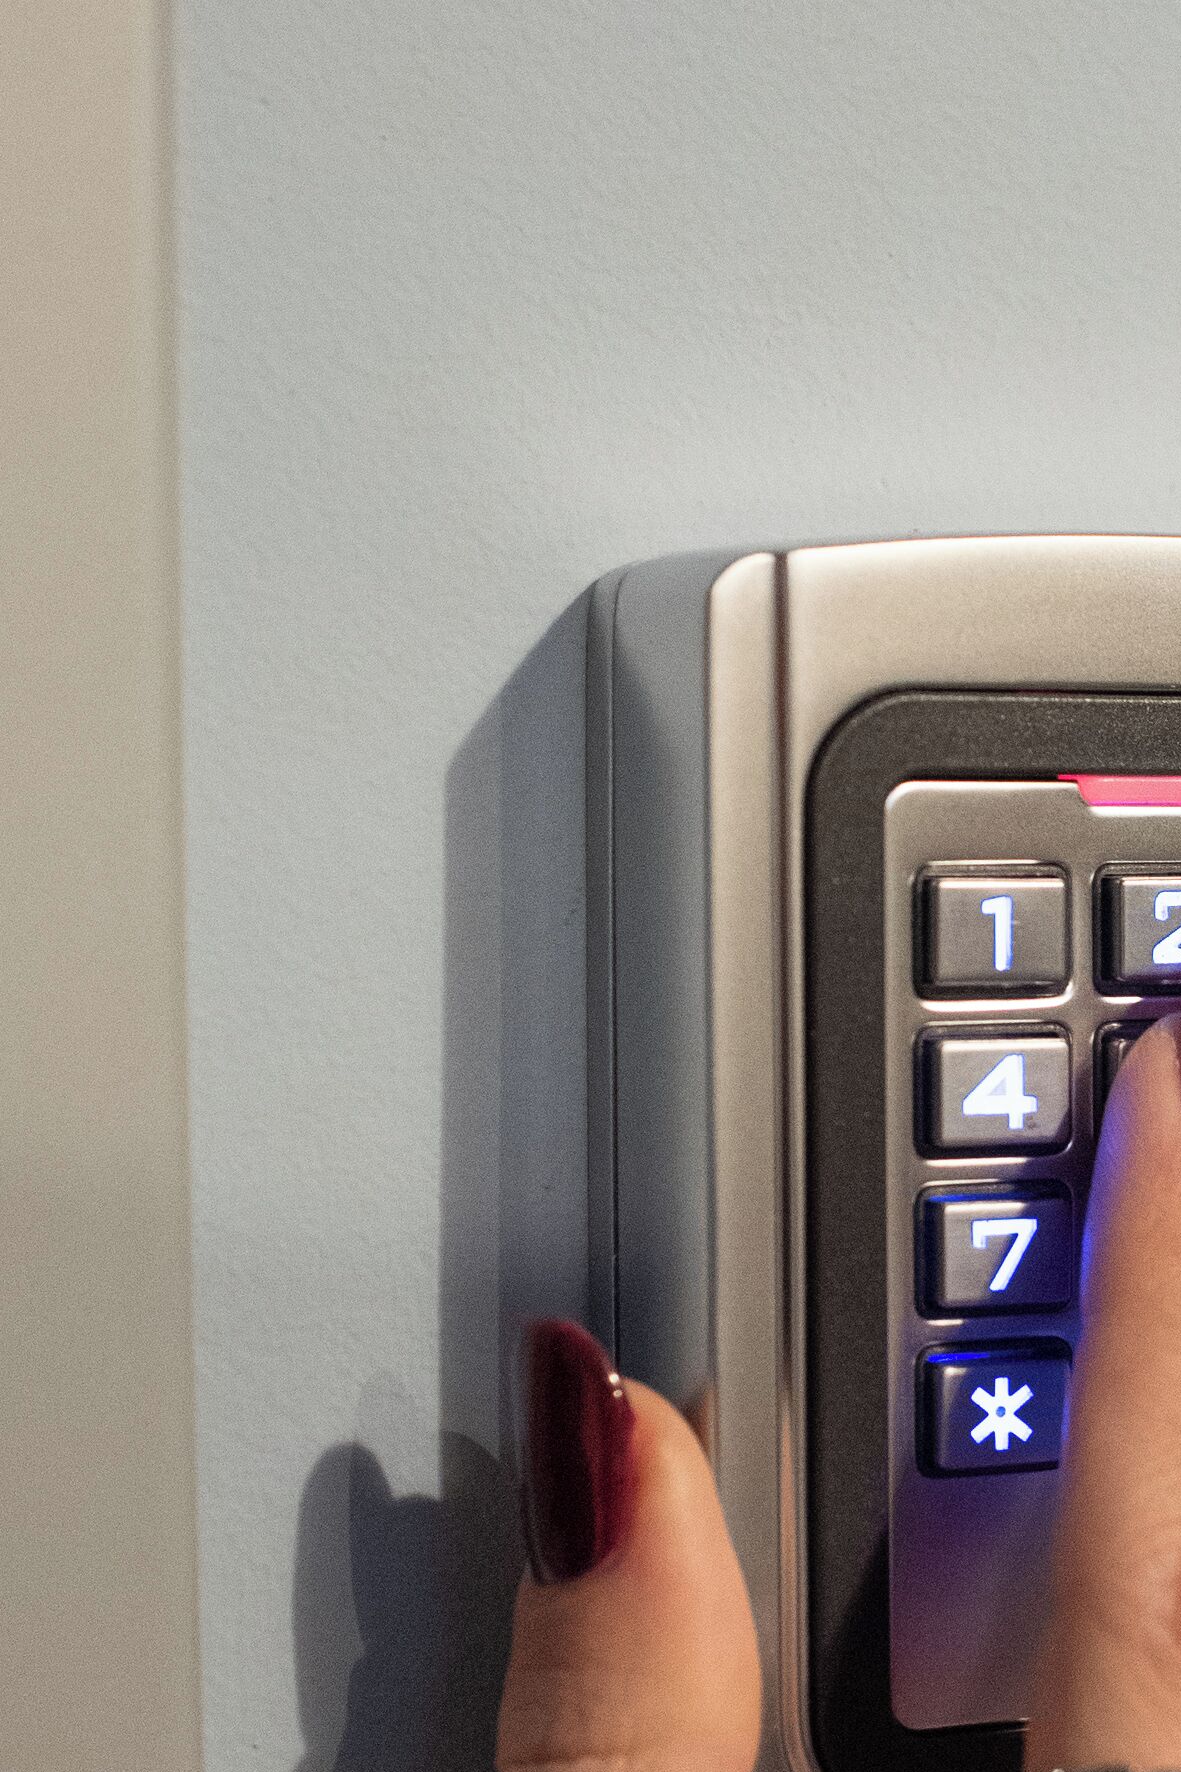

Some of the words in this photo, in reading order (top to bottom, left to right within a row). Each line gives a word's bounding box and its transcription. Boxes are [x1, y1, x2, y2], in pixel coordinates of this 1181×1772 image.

[980, 894, 1014, 972] 1
[961, 1052, 1039, 1131] 4
[970, 1216, 1039, 1293] 7
